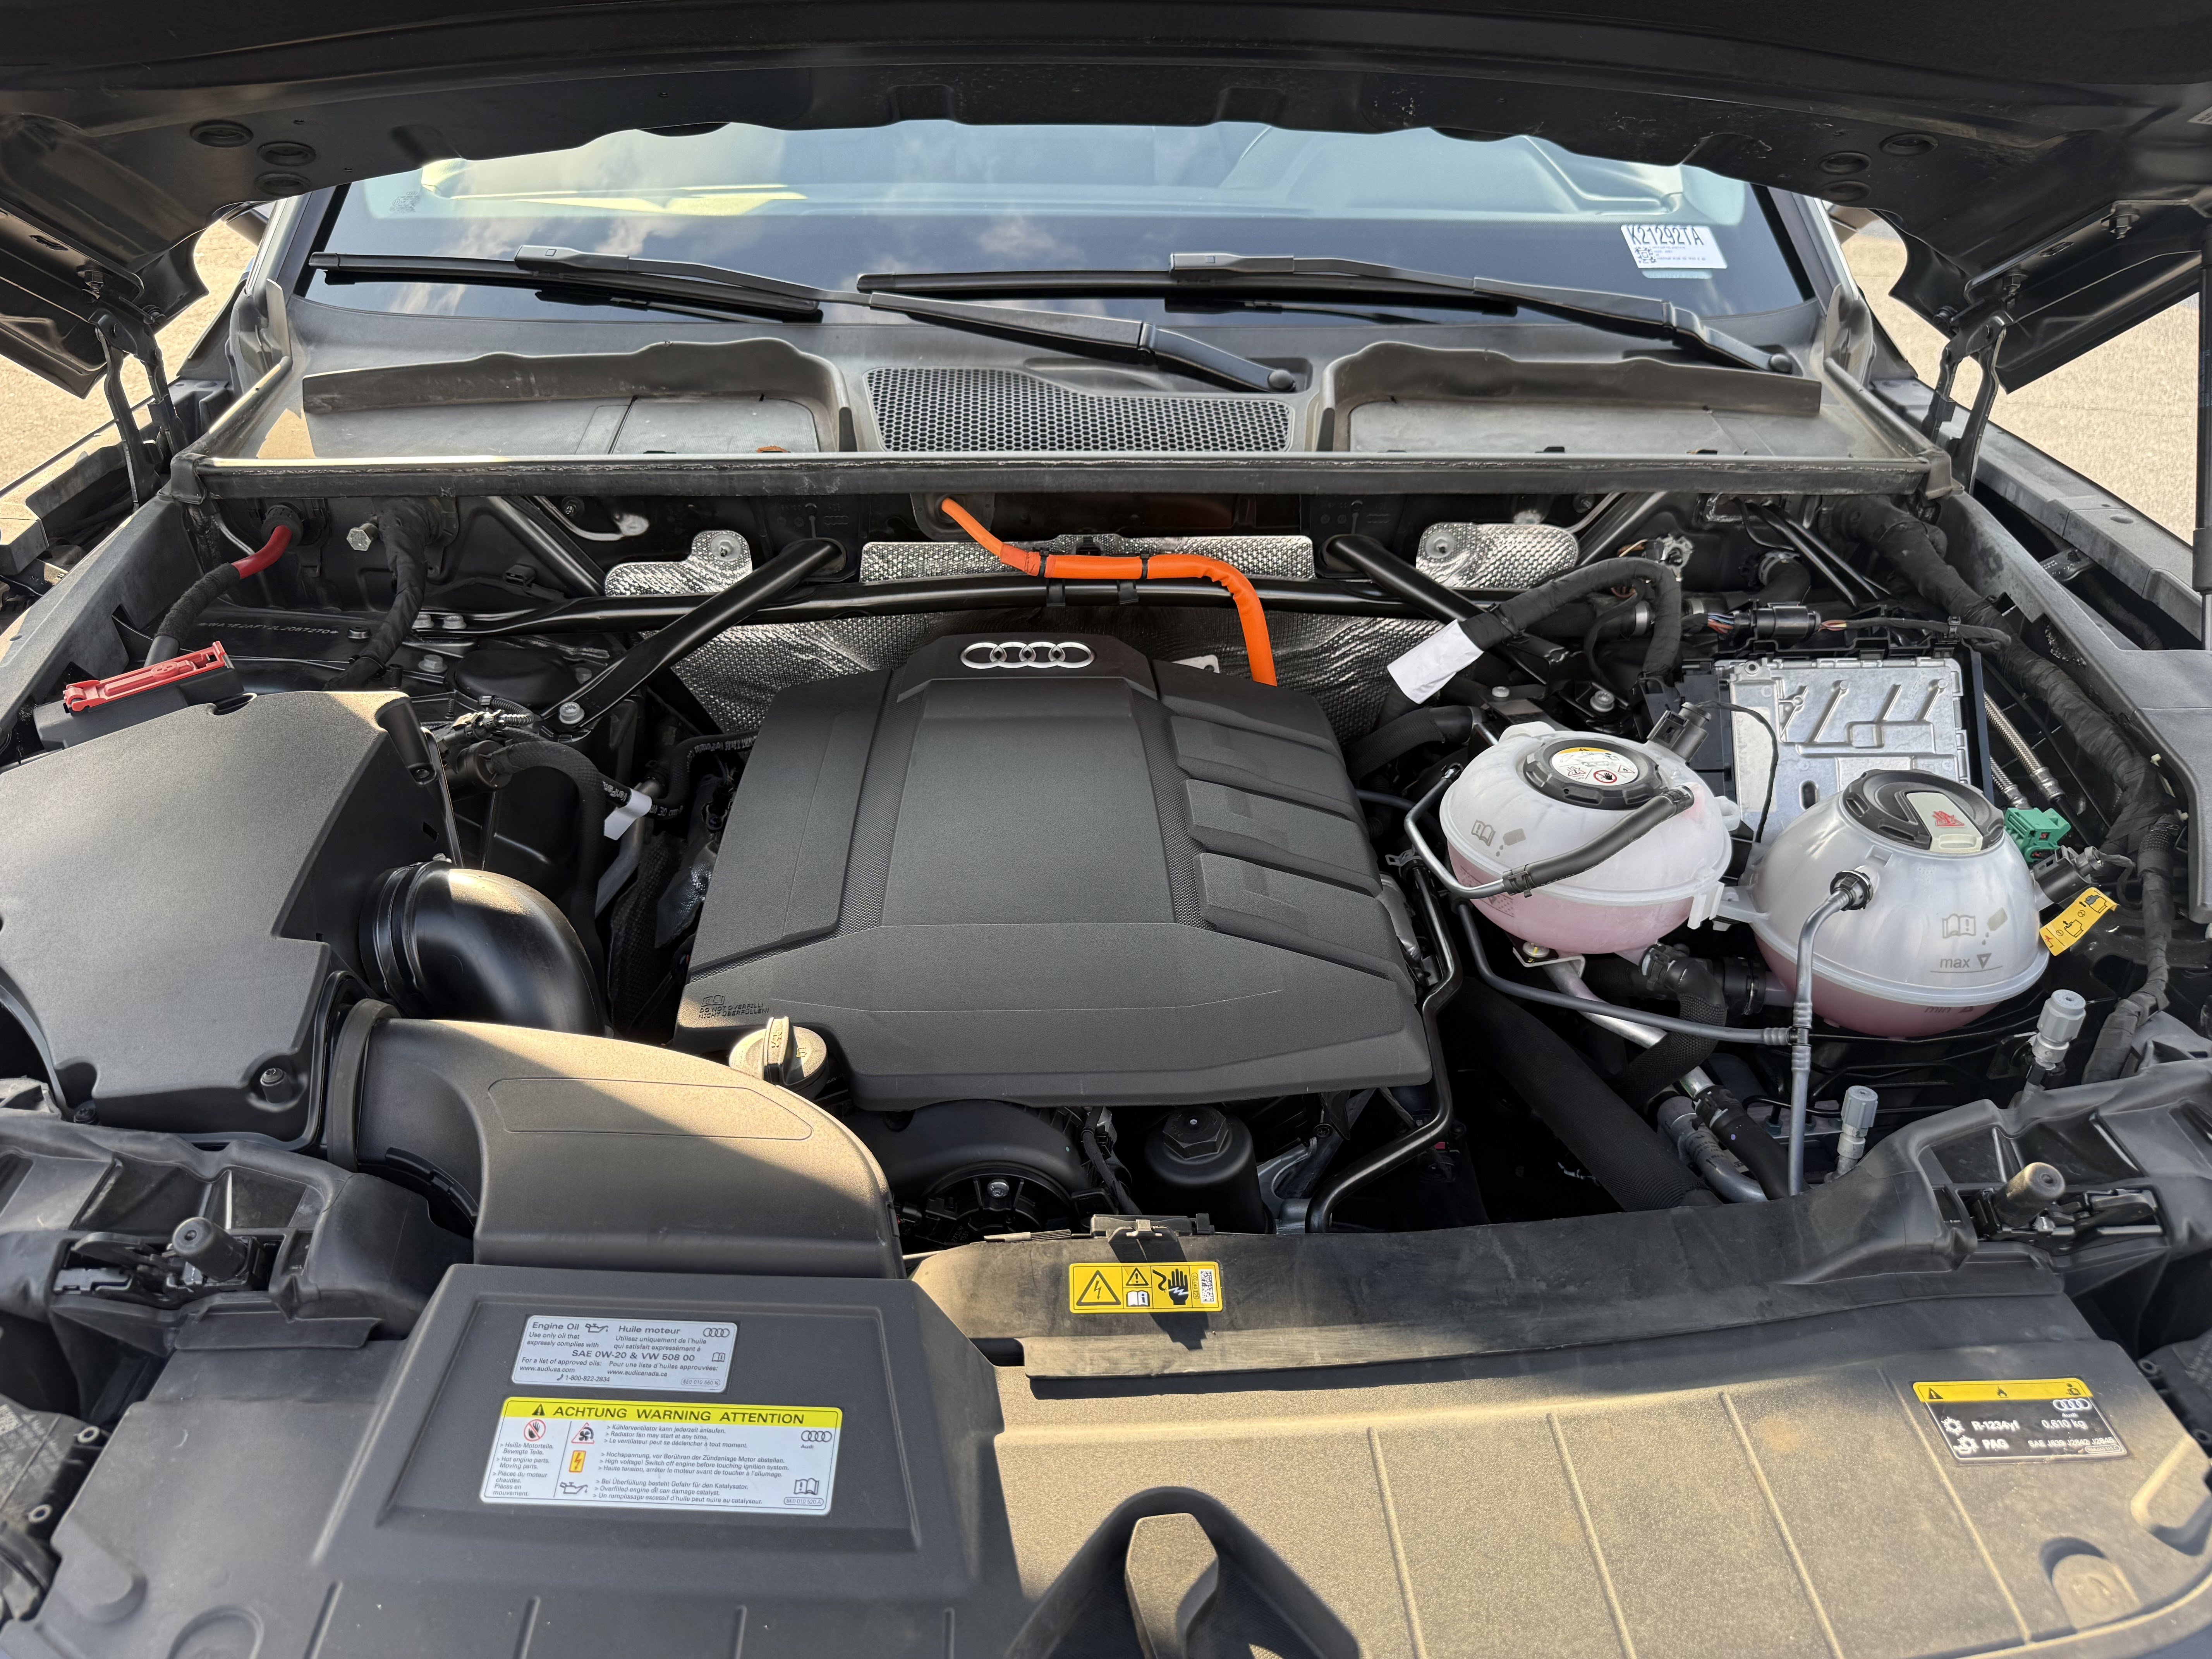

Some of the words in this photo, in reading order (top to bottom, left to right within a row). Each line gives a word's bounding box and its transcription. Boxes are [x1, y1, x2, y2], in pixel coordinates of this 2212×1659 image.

[1627, 225, 1704, 245] K21292TA
[1940, 958, 1970, 968] max
[532, 1322, 563, 1330] Engine
[552, 1406, 627, 1418] ACHTUNG
[636, 1409, 711, 1421] WARNING
[719, 1412, 804, 1424] ATTENTION
[1972, 1421, 2020, 1431] R-1234yf
[2071, 1420, 2087, 1429] kg
[1982, 1439, 2010, 1449] PAG
[606, 1451, 651, 1459] Hochspannung,
